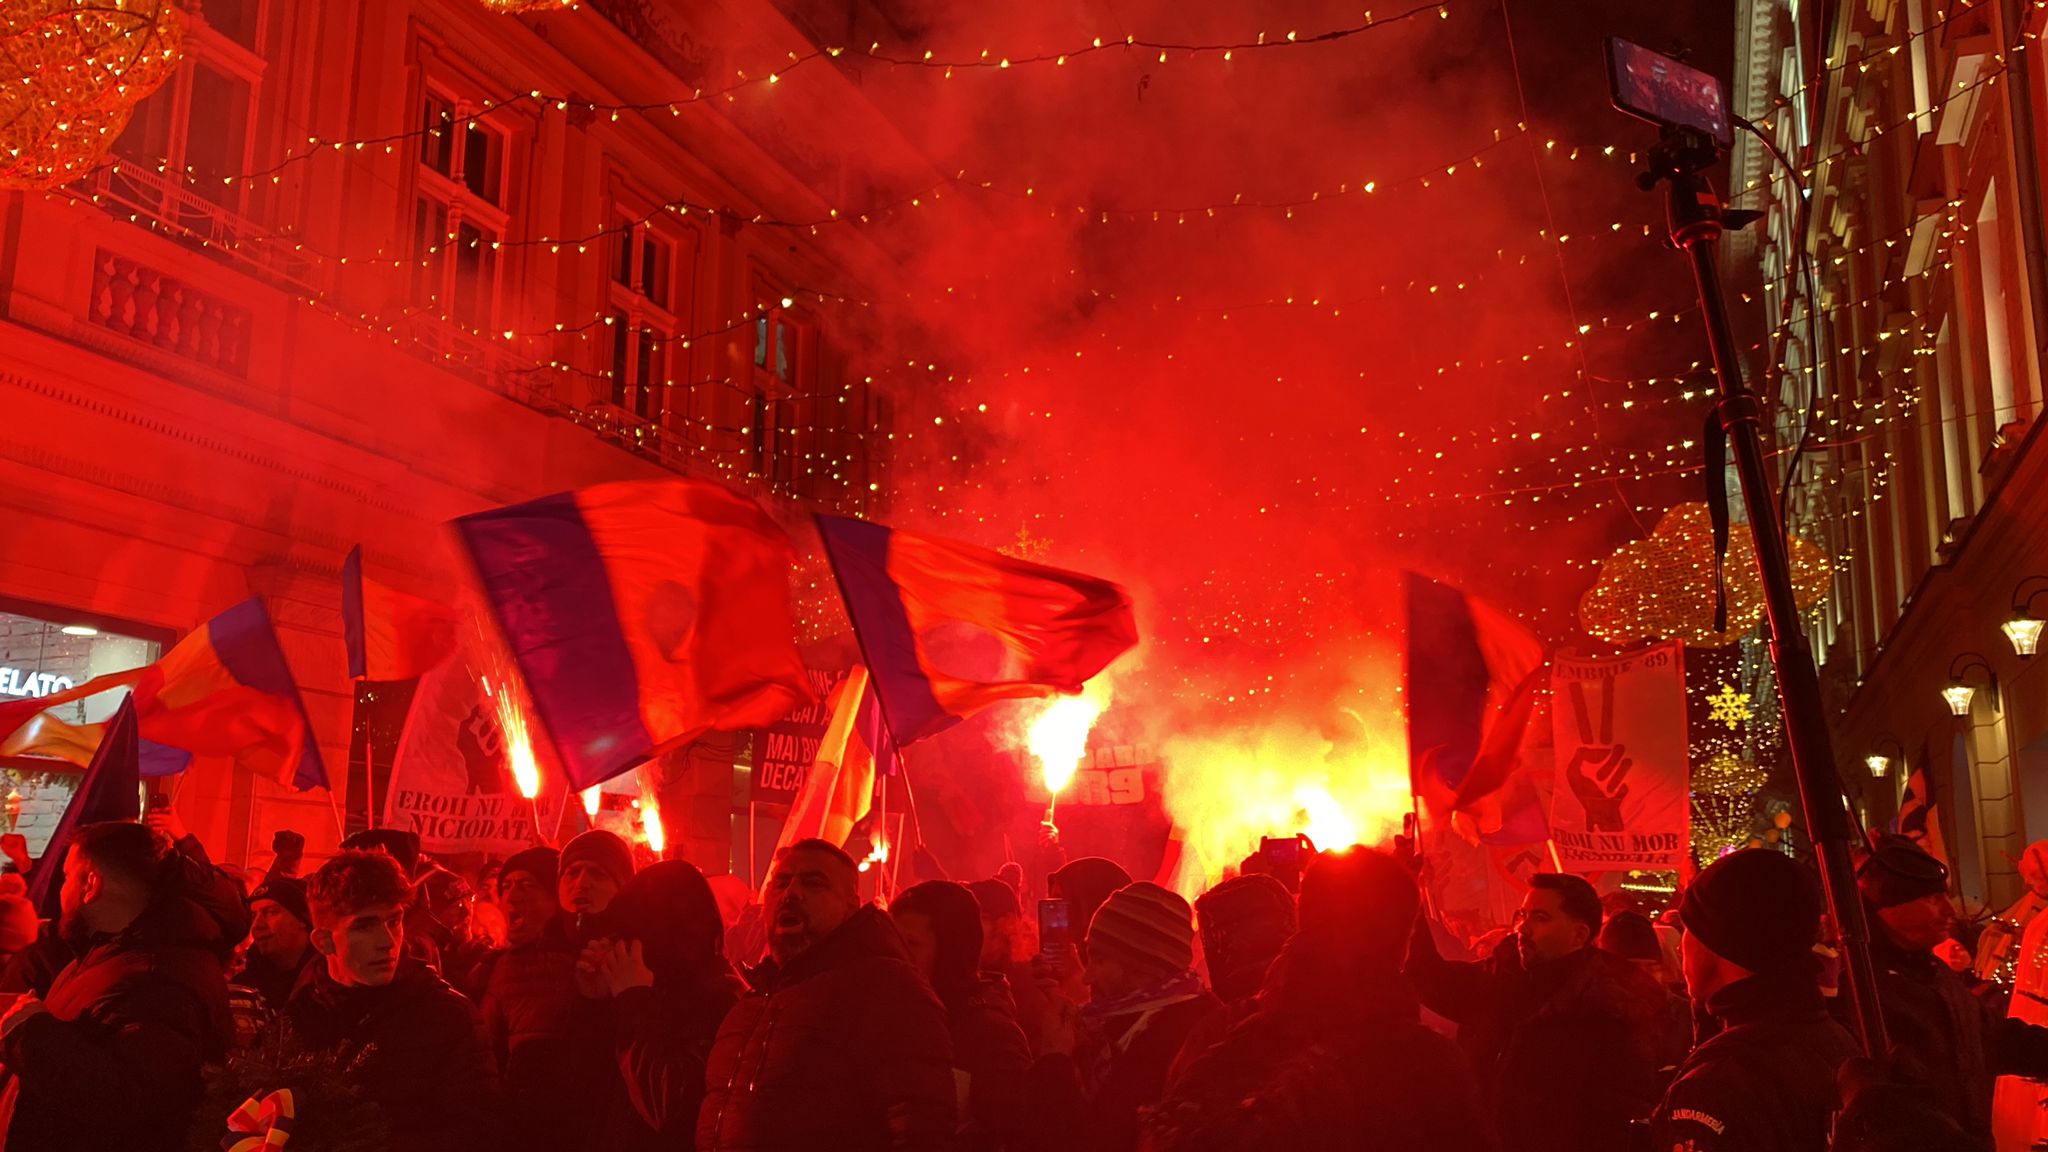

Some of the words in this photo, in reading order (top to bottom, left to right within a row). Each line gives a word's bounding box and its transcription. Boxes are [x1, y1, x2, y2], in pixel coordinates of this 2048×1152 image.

[0, 667, 73, 698] ELATO
[1556, 661, 1632, 680] EMBRIE
[766, 732, 799, 762] MAI
[398, 790, 470, 817] EROII
[475, 798, 505, 818] NU
[409, 812, 534, 842] NICIODAT
[1599, 835, 1625, 852] NU
[1632, 832, 1679, 853] MOR
